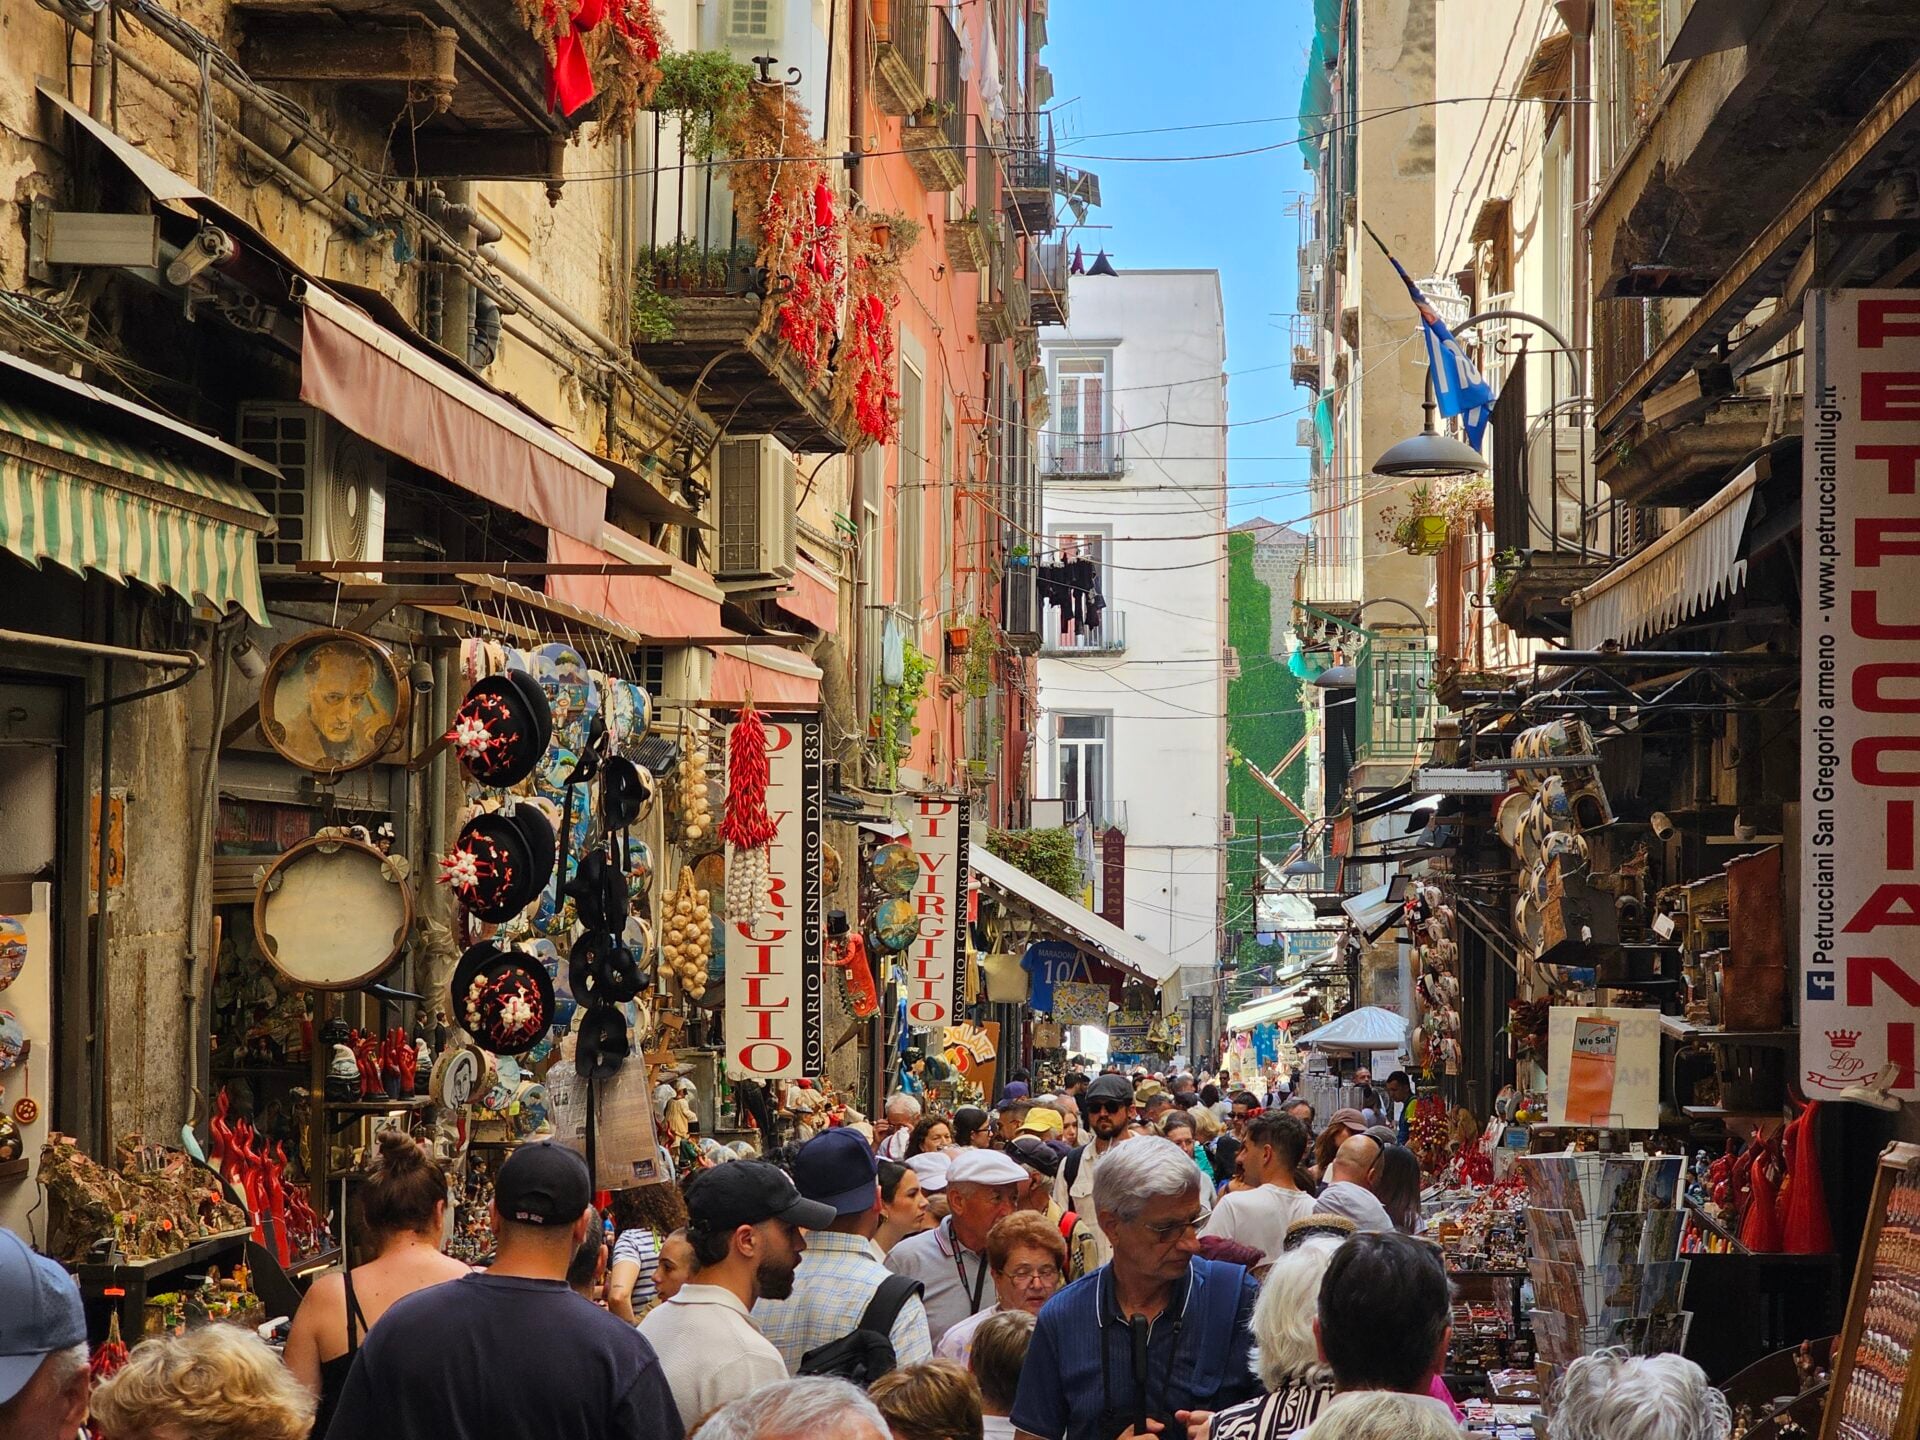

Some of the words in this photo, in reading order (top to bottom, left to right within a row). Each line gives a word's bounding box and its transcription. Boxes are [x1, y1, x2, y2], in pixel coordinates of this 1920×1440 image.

[1818, 634, 1835, 709] armeno
[805, 723, 820, 769] 1830
[1812, 715, 1840, 803] Gregorio
[806, 780, 820, 822] DAL
[915, 796, 952, 838] DI
[1812, 809, 1835, 846] San
[959, 834, 970, 861] DAL
[804, 831, 820, 946] GENNARO
[956, 867, 970, 941] GENNARO
[1107, 846, 1121, 915] CAPUANO
[1812, 853, 1835, 964] Petrucciani
[806, 955, 819, 964] E
[910, 853, 952, 1022] VIRGILIO
[953, 960, 967, 1022] ROSARIO
[1044, 960, 1071, 984] 10
[805, 974, 820, 1072] ROSARIO
[1578, 1037, 1594, 1046] We
[1595, 1036, 1611, 1044] Sell
